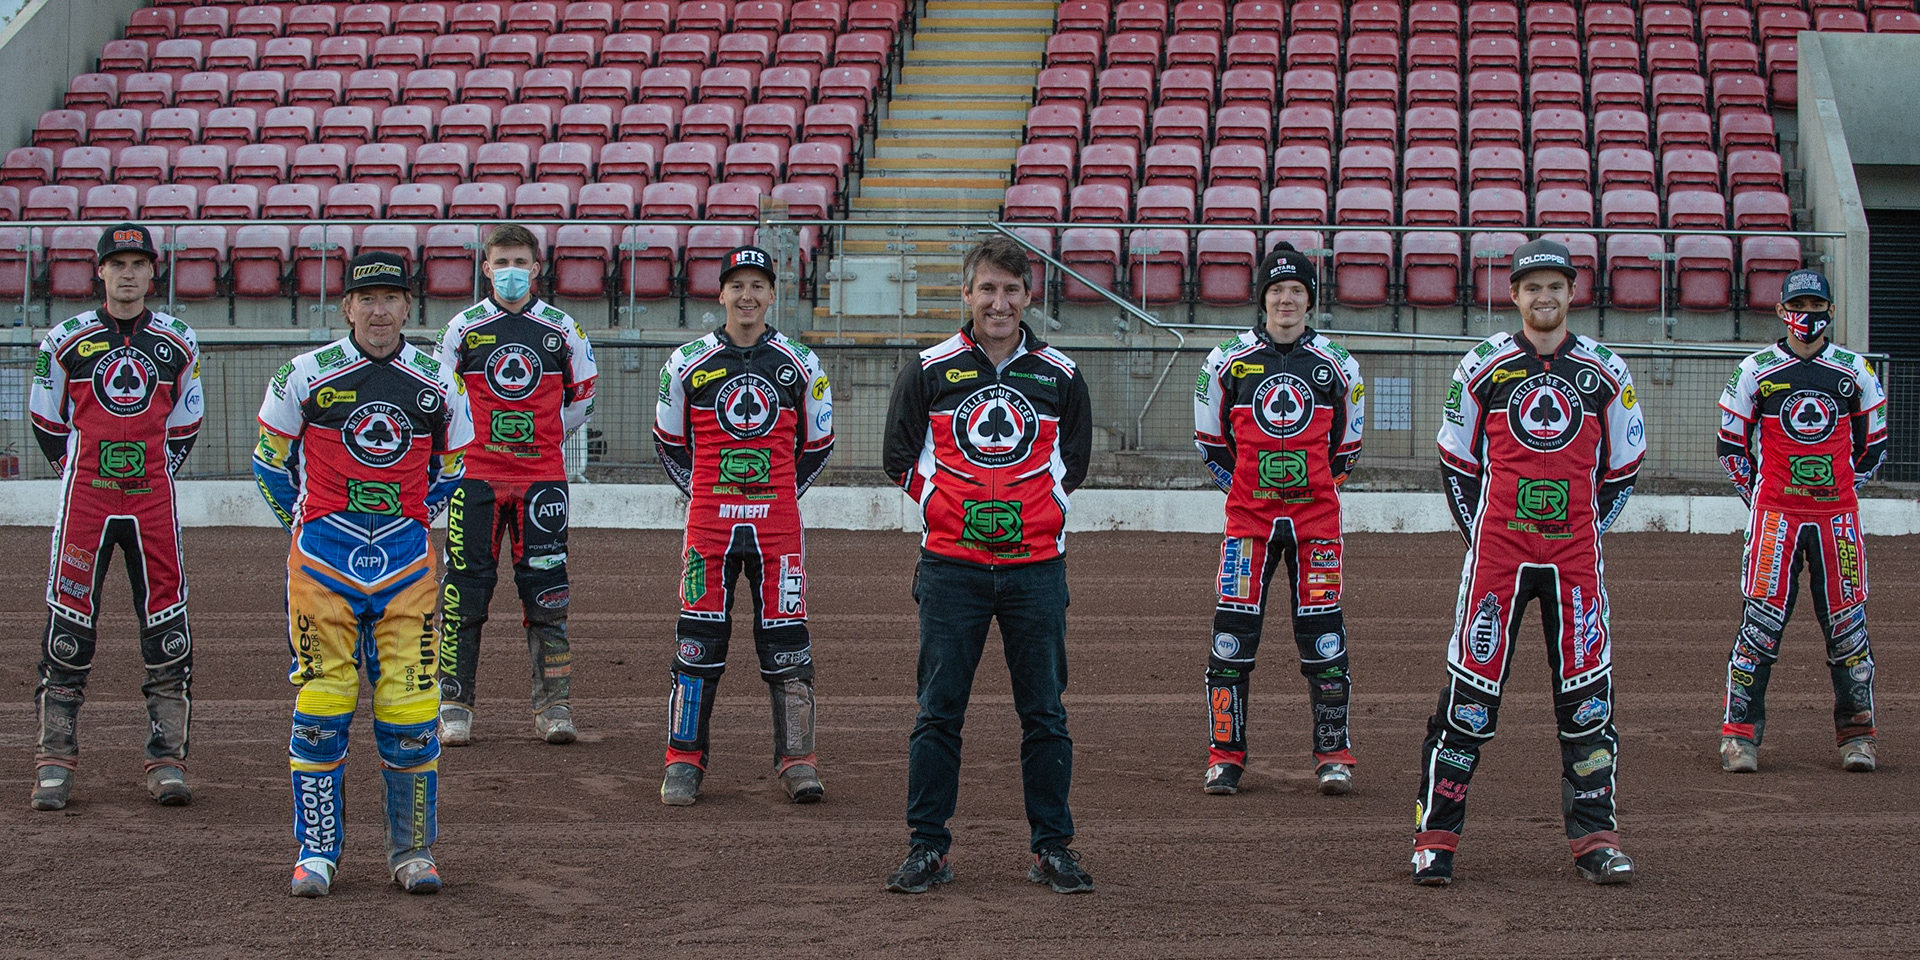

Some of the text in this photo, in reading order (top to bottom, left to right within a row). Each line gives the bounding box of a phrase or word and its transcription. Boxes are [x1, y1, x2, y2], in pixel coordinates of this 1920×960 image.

[741, 250, 765, 264] FTS
[1519, 253, 1565, 266] POLCOPPER
[159, 346, 169, 358] 4
[488, 348, 508, 368] BELLE
[525, 349, 539, 368] ACES
[96, 351, 117, 375] BELLE
[140, 356, 155, 377] ACES
[1317, 369, 1329, 380] 5
[719, 381, 739, 403] BELLE
[760, 384, 776, 403] ACES
[1256, 380, 1276, 400] BELLE
[1295, 383, 1311, 401] ACES
[1512, 380, 1534, 406] BELLE
[1561, 385, 1579, 408] ACES
[1842, 381, 1851, 393] 7
[958, 393, 986, 420] BELLE
[1013, 399, 1034, 423] ACES
[1820, 395, 1835, 411] ACES
[347, 407, 370, 430] BELLE
[373, 405, 392, 414] VUE
[537, 501, 566, 518] ATPI
[449, 487, 467, 571] CARPETS
[354, 556, 382, 567] ATPI
[1752, 511, 1780, 598] MOTORVATION
[1768, 520, 1787, 595] TRAINING LTD
[1221, 538, 1239, 596] ALBON
[1838, 539, 1852, 599] ROSE UK
[1847, 544, 1859, 586] ELLIE
[60, 584, 85, 599] PROJECT
[786, 576, 803, 613] FTS
[56, 639, 74, 654] ATPI
[166, 638, 184, 652] ATPI
[1218, 640, 1234, 650] ATPI
[1321, 639, 1336, 650] ATPI
[1441, 750, 1462, 763] ROCK
[301, 775, 322, 853] HAGON
[318, 775, 336, 852] SHOCKS
